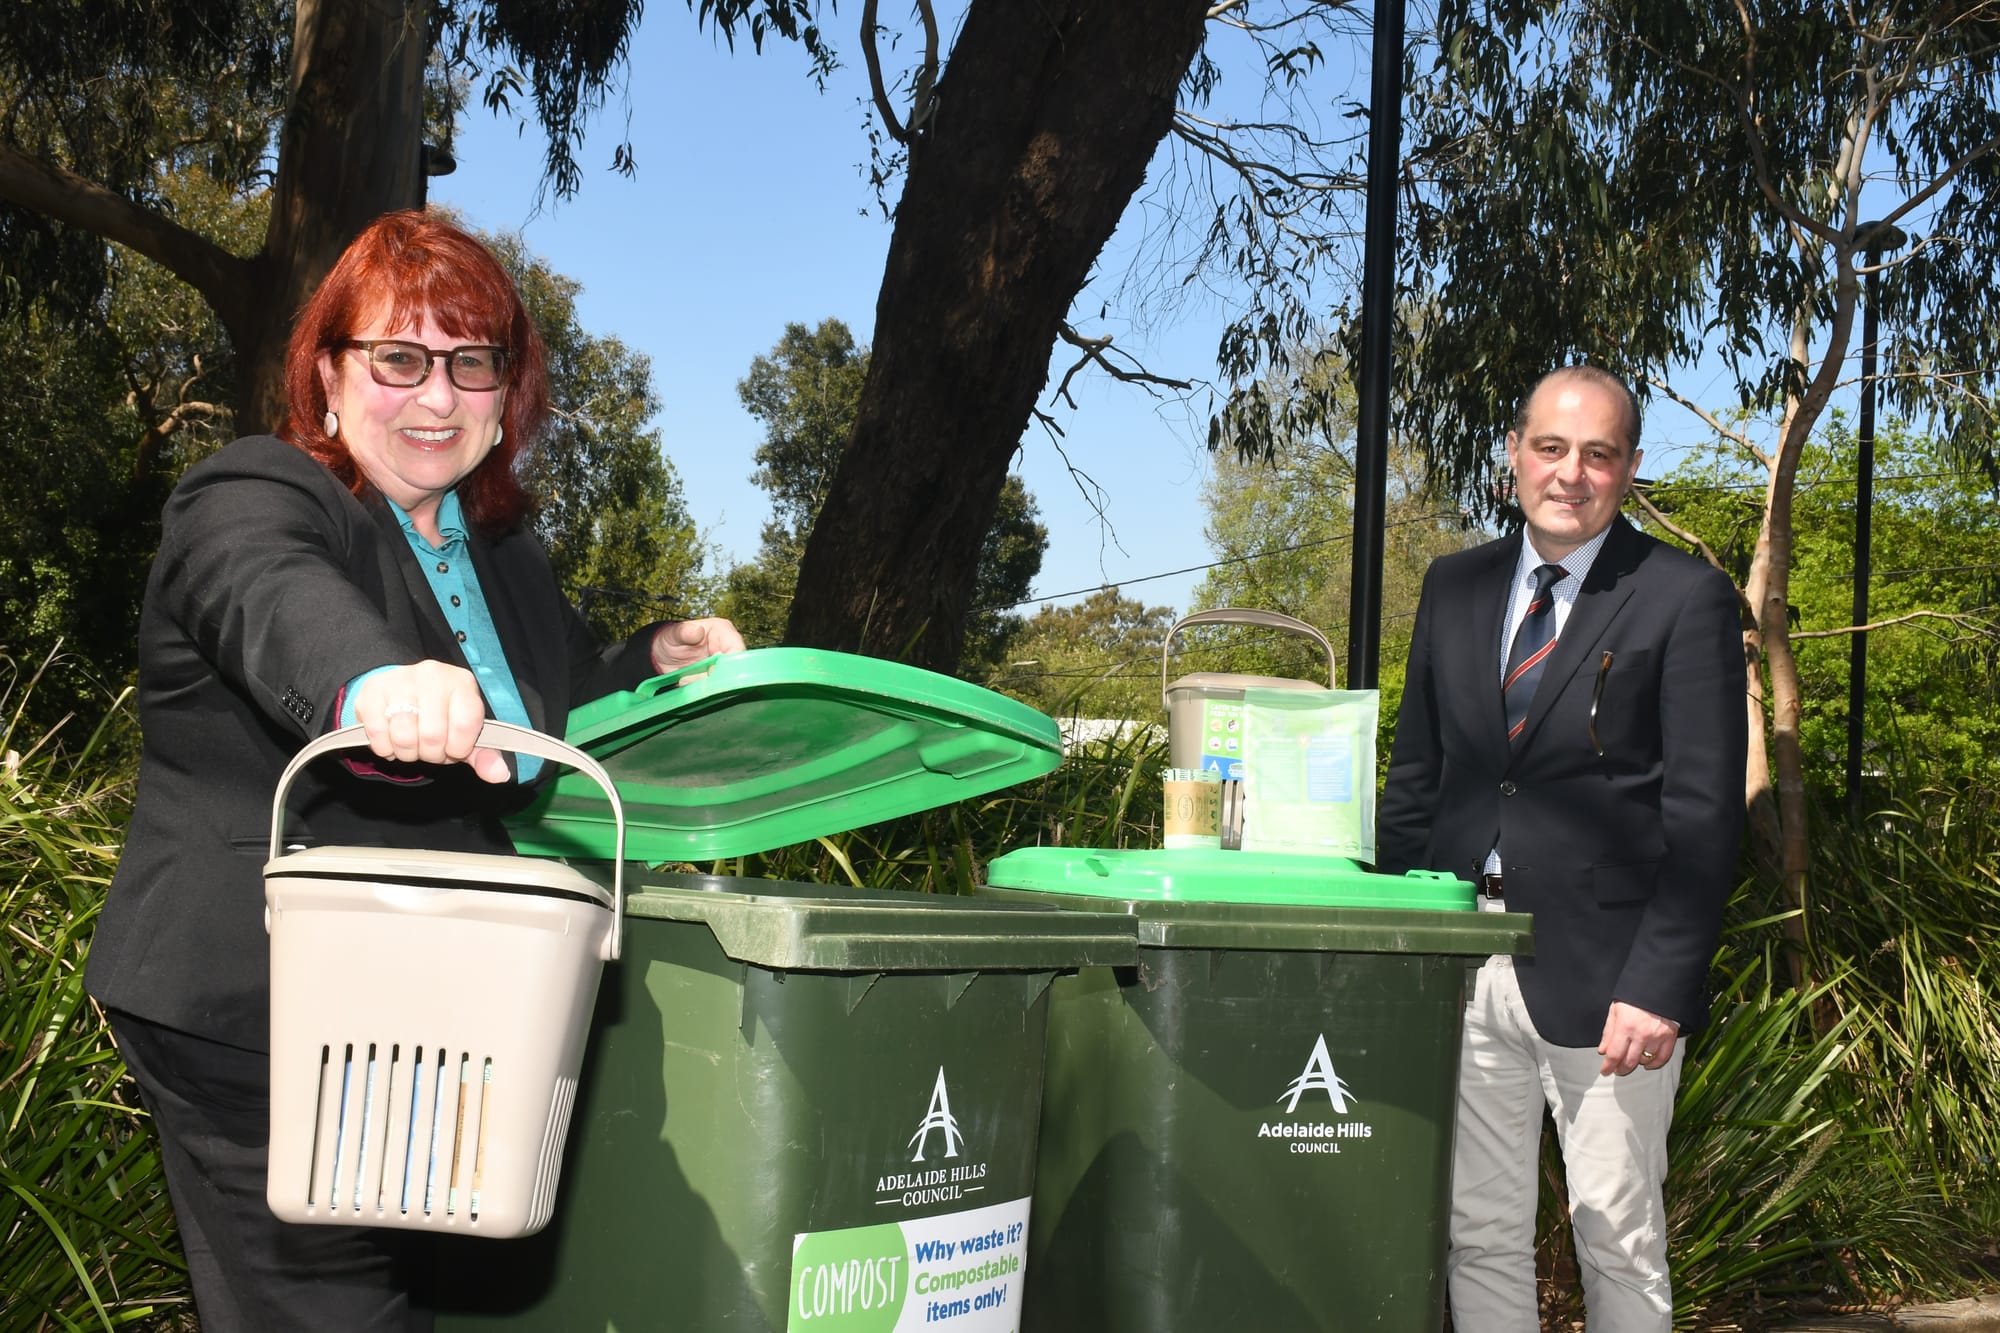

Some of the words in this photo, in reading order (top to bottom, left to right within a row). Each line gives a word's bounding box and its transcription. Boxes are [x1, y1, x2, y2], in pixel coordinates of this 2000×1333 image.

[1257, 1122, 1334, 1138] Adelaide
[1337, 1122, 1372, 1138] Hills
[1290, 1142, 1341, 1154] COUNCIL
[876, 1169, 947, 1192] ADELAIDE
[950, 1163, 986, 1182] HILLS
[902, 1185, 962, 1207] COUNCIL
[915, 1240, 956, 1264] Why
[960, 1229, 1004, 1256] waste
[1006, 1222, 1023, 1245] it?
[798, 1256, 901, 1320] COMPOST
[914, 1253, 1019, 1295] Compostable
[926, 1296, 970, 1322] items
[974, 1284, 1007, 1313] only!
